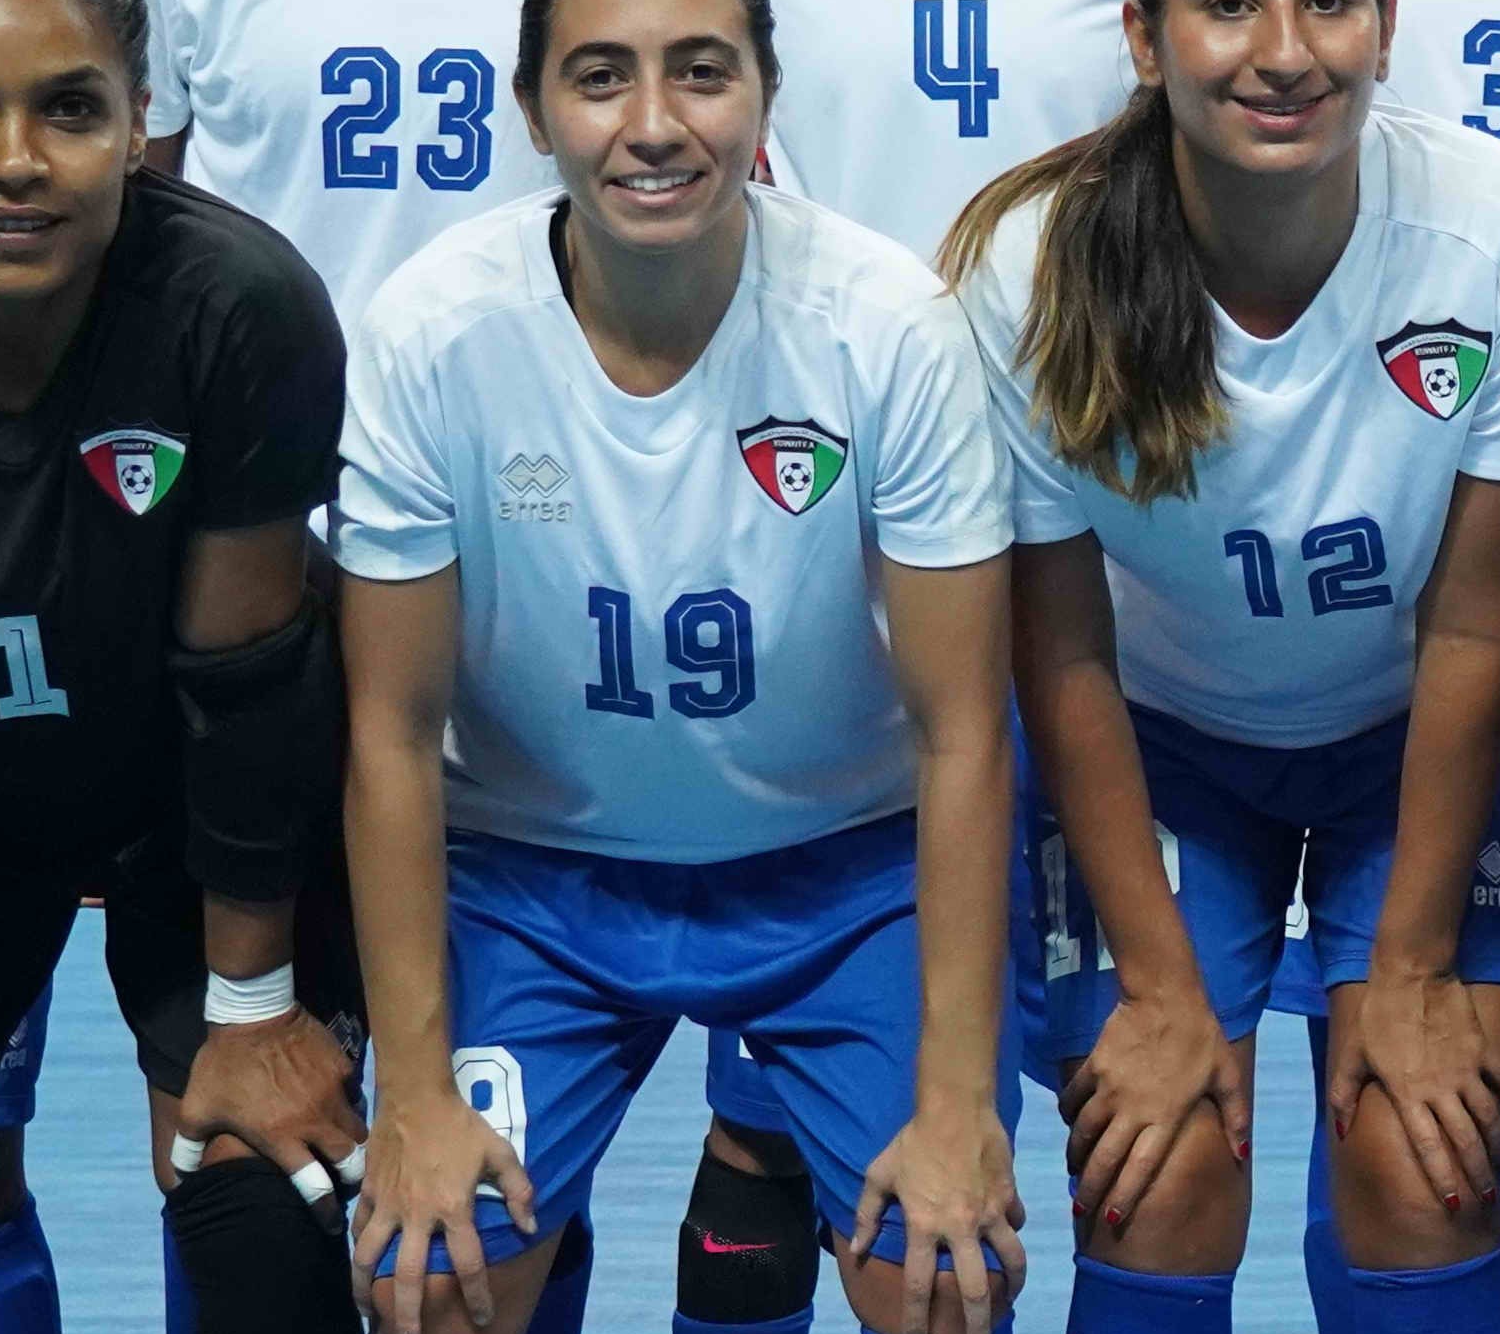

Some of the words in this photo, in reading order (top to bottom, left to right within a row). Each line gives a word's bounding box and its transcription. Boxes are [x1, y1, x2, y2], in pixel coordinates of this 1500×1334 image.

[320, 46, 496, 192] 23
[499, 498, 573, 523] errea
[1223, 516, 1394, 618] 12
[584, 585, 758, 721] 19
